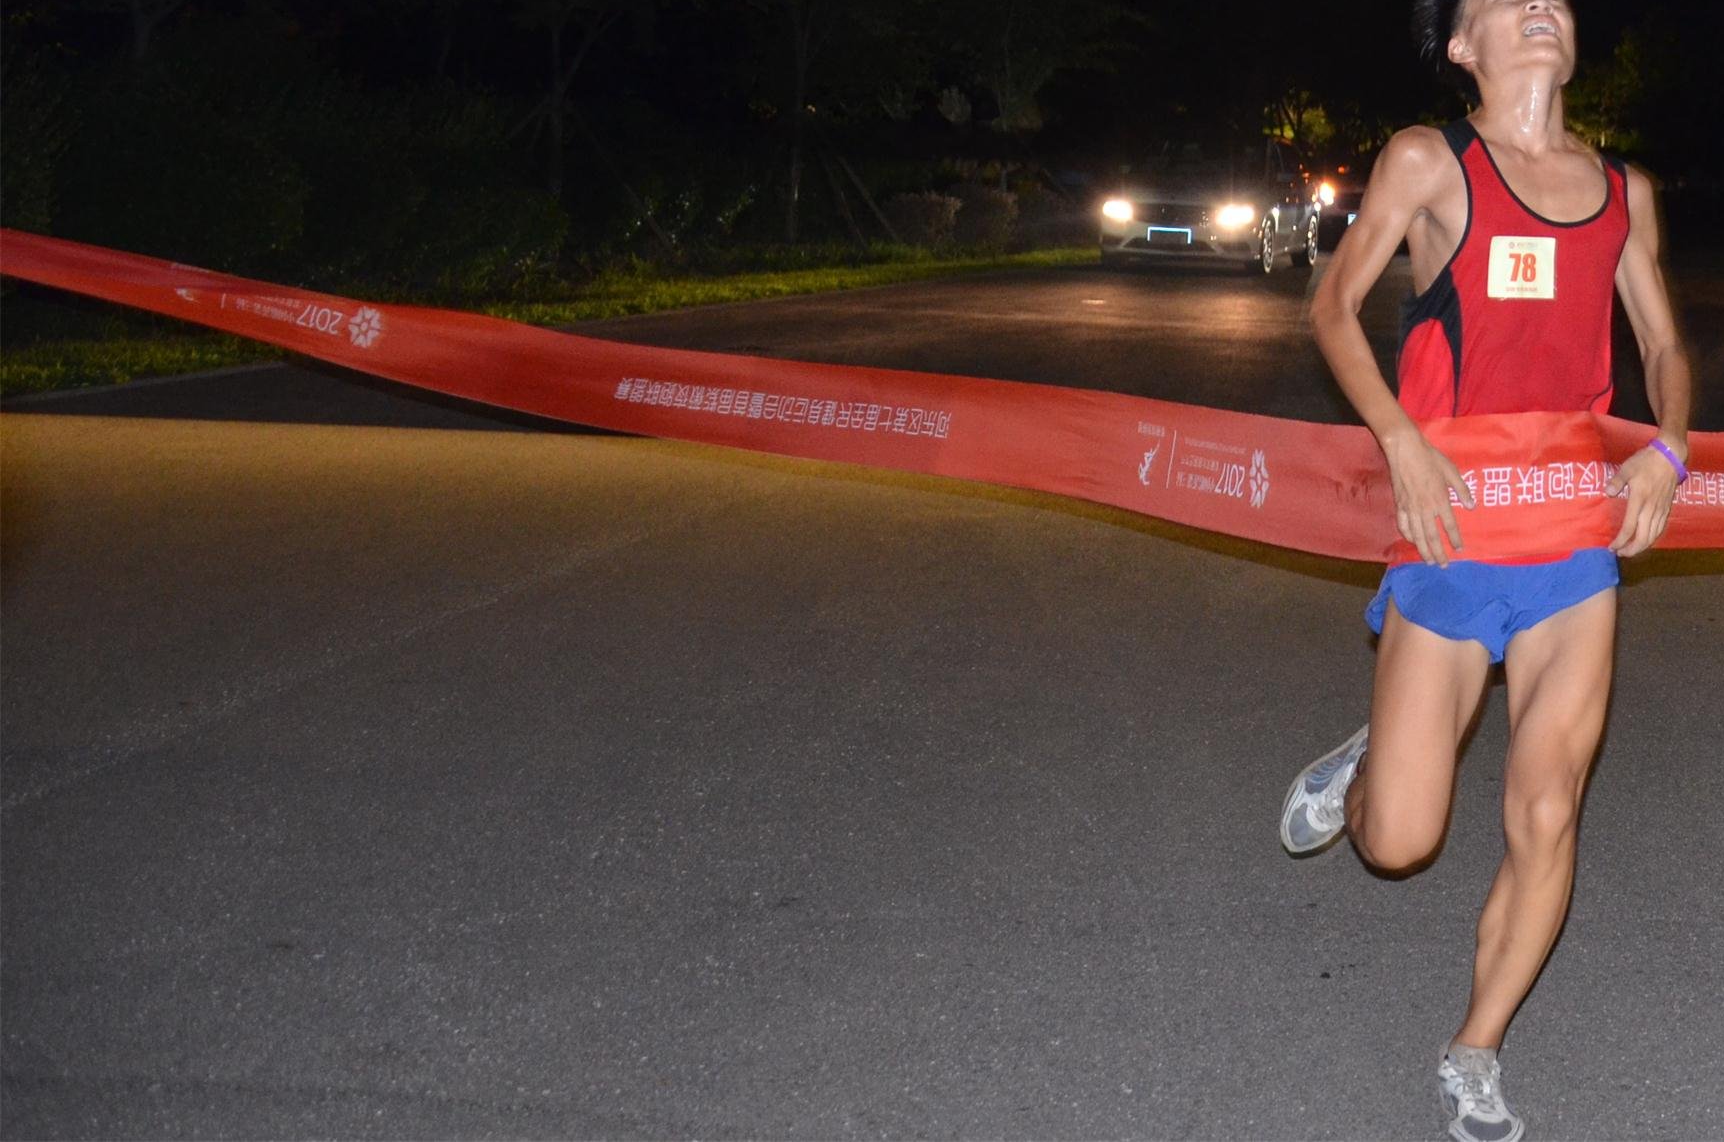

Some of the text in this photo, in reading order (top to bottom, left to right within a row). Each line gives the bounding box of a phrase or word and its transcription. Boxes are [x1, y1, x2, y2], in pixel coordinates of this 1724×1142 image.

[1509, 253, 1537, 282] 78
[296, 304, 344, 335] 2017
[1214, 462, 1246, 499] 2017
